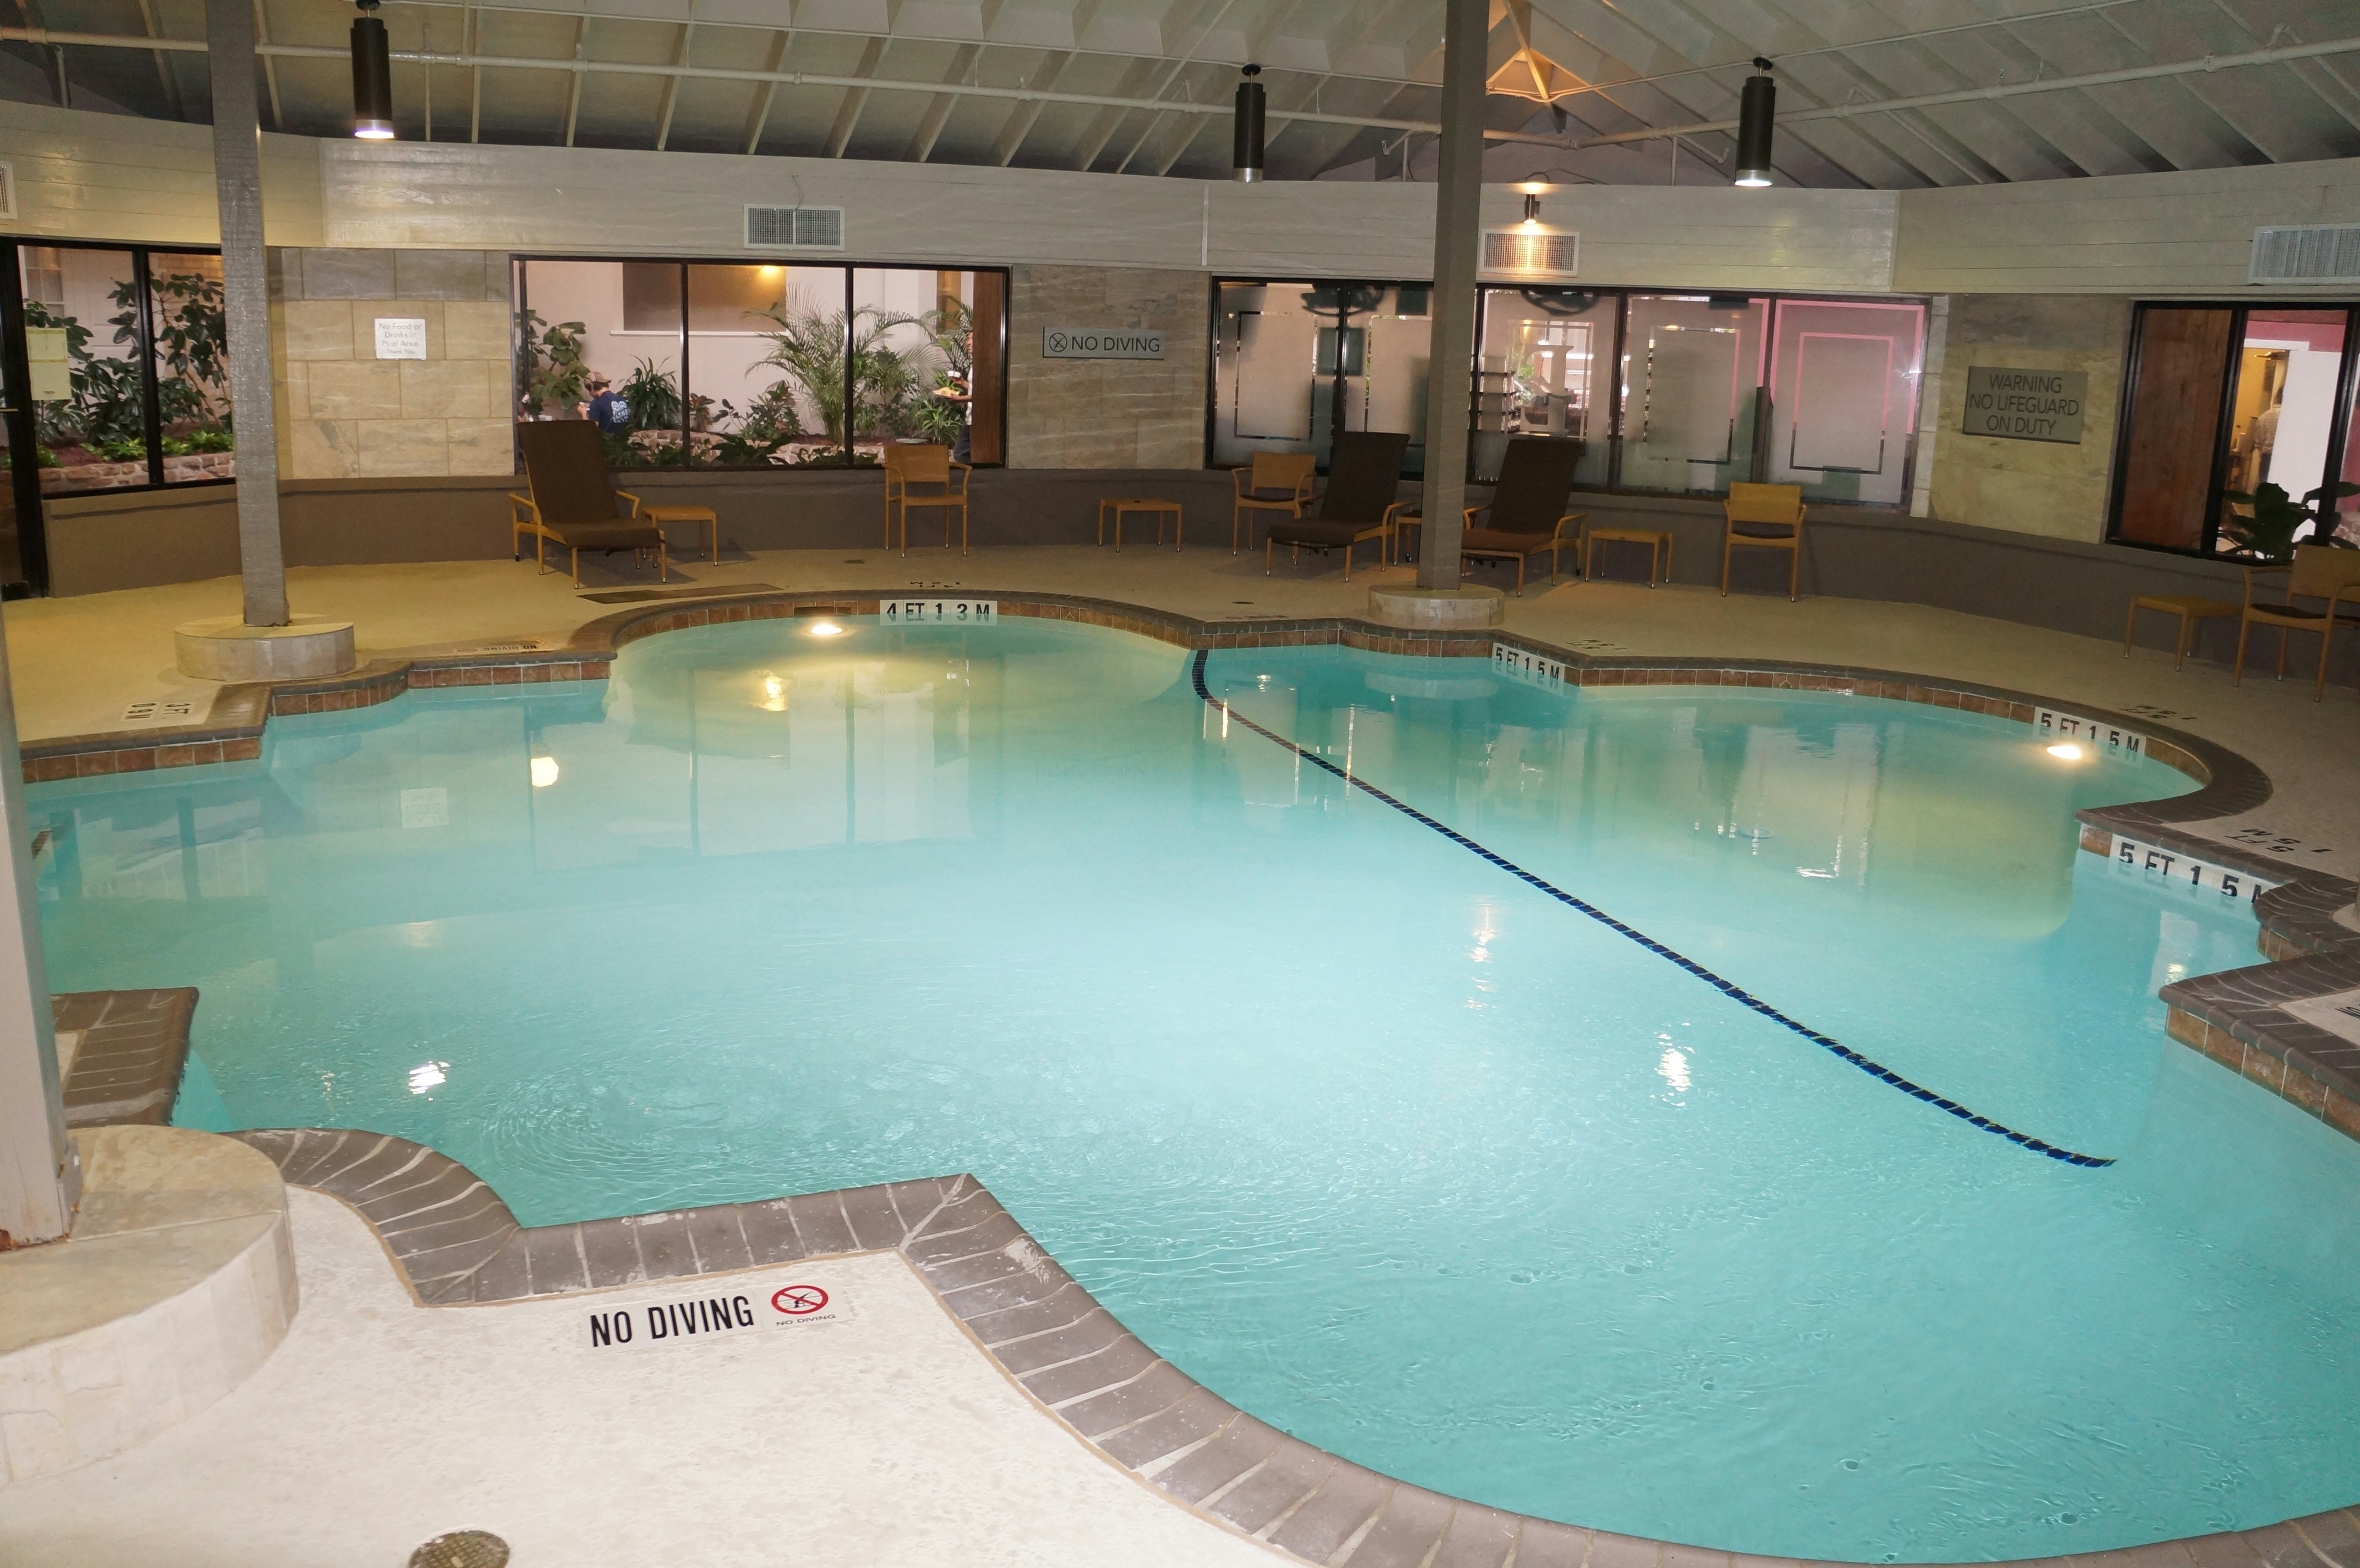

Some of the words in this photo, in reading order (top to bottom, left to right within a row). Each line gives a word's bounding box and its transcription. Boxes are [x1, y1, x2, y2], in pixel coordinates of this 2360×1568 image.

[1071, 336, 1098, 351] NO
[1104, 337, 1160, 352] DIVING
[1989, 374, 2062, 393] WARNING
[1970, 393, 1993, 409] NO
[1997, 394, 2079, 416] LIFEGUARD
[1987, 415, 2010, 432] ON
[2015, 416, 2056, 435] DUTY
[886, 603, 896, 613] 4
[906, 603, 925, 613] FT
[935, 603, 942, 613] 1
[976, 604, 989, 614] M
[1496, 647, 1503, 661] 5
[1506, 650, 1519, 666] FT
[1525, 657, 1530, 670] 1
[1538, 661, 1545, 675] 5
[1549, 665, 1560, 680] M
[2041, 713, 2052, 728] 5
[2060, 717, 2079, 734] FT
[2089, 725, 2096, 740] 1
[2109, 730, 2120, 746] 5
[2126, 736, 2139, 753] M
[2119, 842, 2135, 864] 5
[2145, 850, 2175, 876] FT
[2190, 865, 2201, 886] 1
[2220, 873, 2239, 897] 5
[590, 1311, 632, 1348] NO
[648, 1295, 754, 1340] DIVING
[797, 1314, 836, 1323] DIVING
